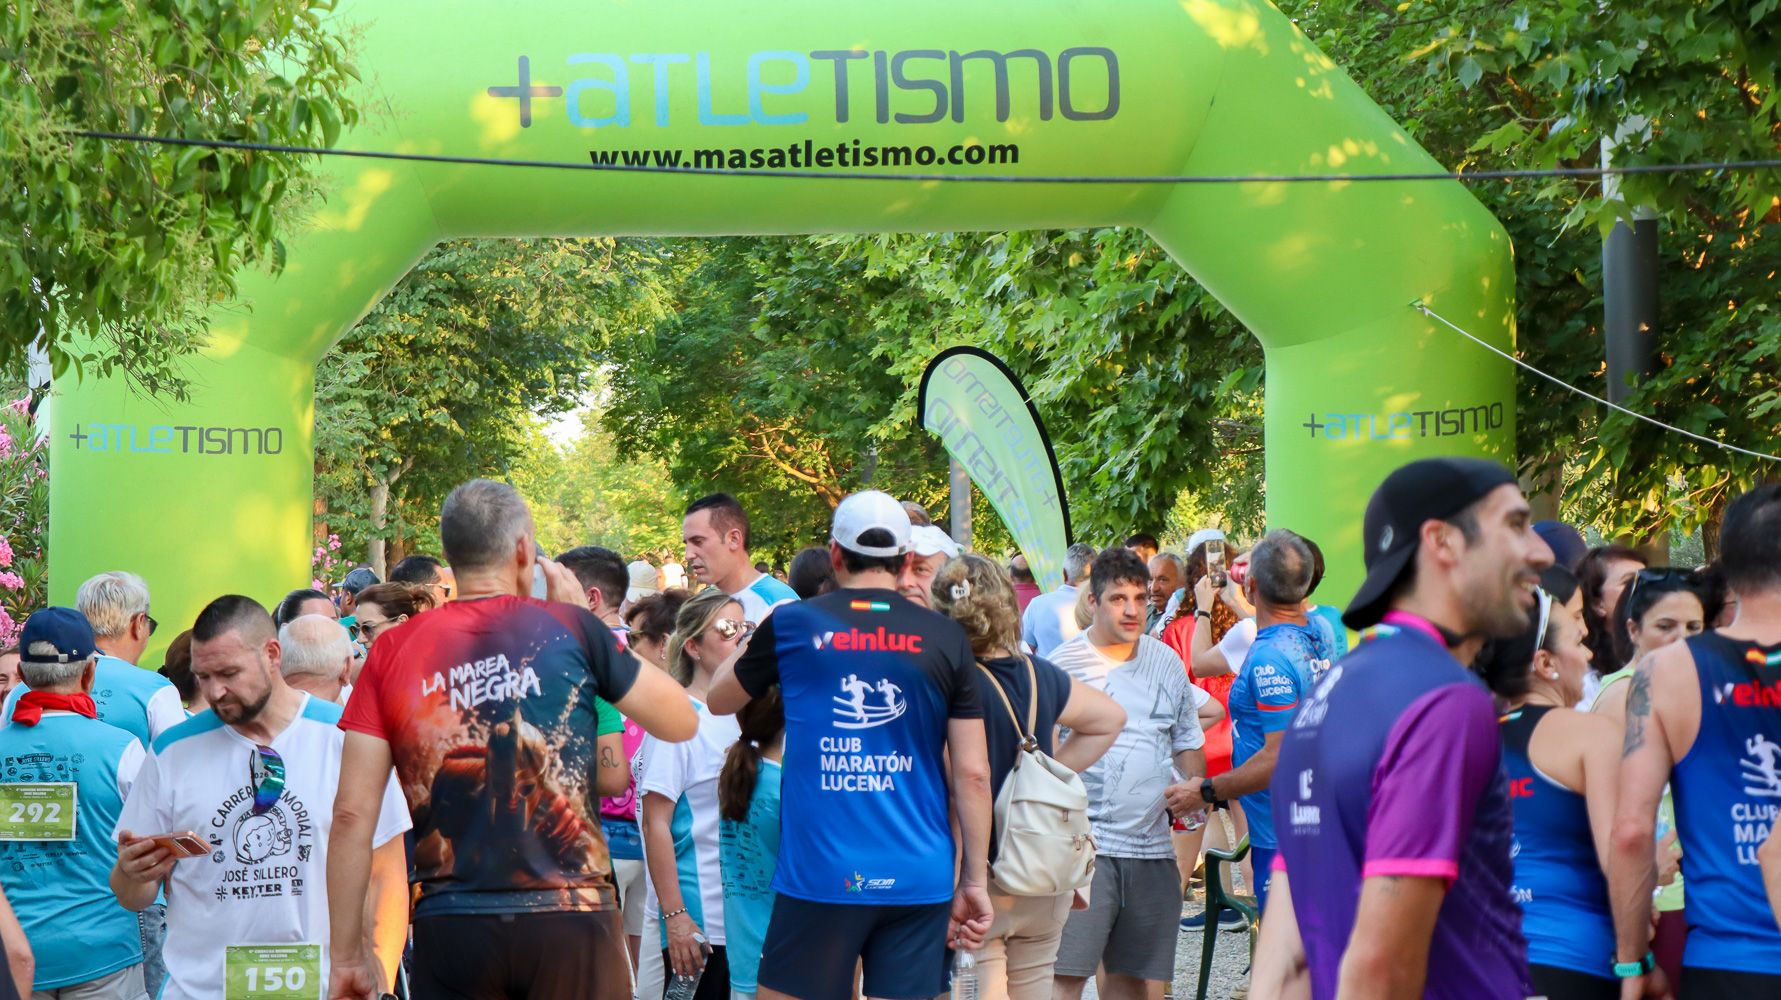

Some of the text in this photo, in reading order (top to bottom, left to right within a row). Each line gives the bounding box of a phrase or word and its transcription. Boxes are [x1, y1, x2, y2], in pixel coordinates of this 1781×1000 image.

[590, 139, 1019, 171] www.masatletismo.com
[450, 653, 510, 687] MAREA
[1253, 664, 1275, 677] Club
[422, 671, 446, 697] LA
[451, 667, 542, 712] NEGRA
[1259, 685, 1293, 698] Lucena
[820, 737, 862, 753] CLUB
[821, 751, 913, 772] MARATÓN
[821, 774, 895, 792] LUCENA
[9, 802, 61, 823] 292
[211, 785, 254, 828] CARRER
[280, 786, 312, 839] MORIAL
[222, 866, 298, 882] JOSÉ SILLERO
[232, 883, 282, 896] KEYTER
[245, 966, 306, 992] 150
